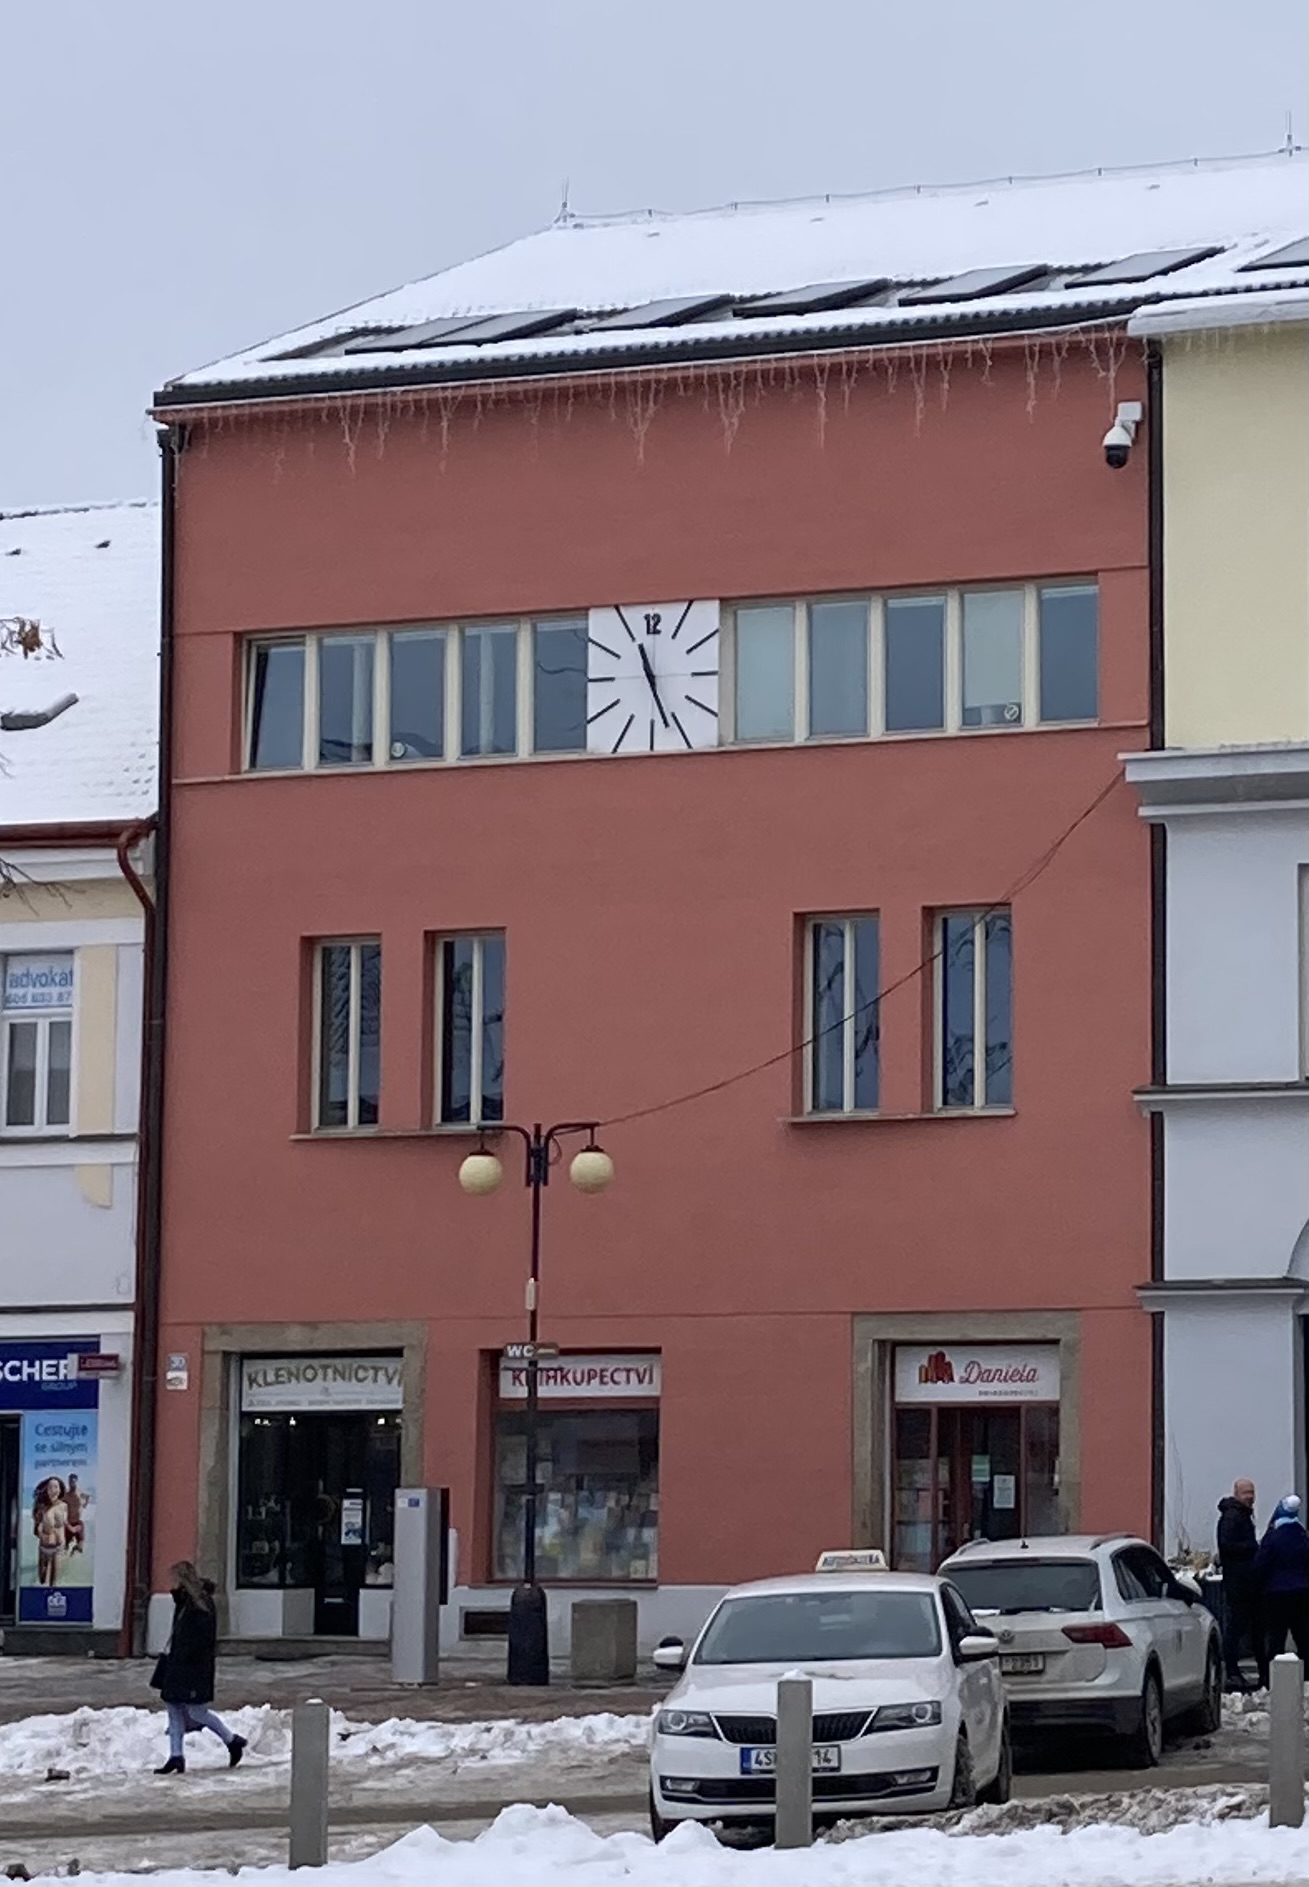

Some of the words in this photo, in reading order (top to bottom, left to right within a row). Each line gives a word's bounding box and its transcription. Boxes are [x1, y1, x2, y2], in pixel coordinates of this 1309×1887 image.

[643, 613, 662, 635] 12
[506, 1345, 534, 1358] WC
[0, 1360, 69, 1381] CHE
[512, 1363, 654, 1386] KIHKUPECTVÍ
[959, 1360, 1039, 1384] Daniela
